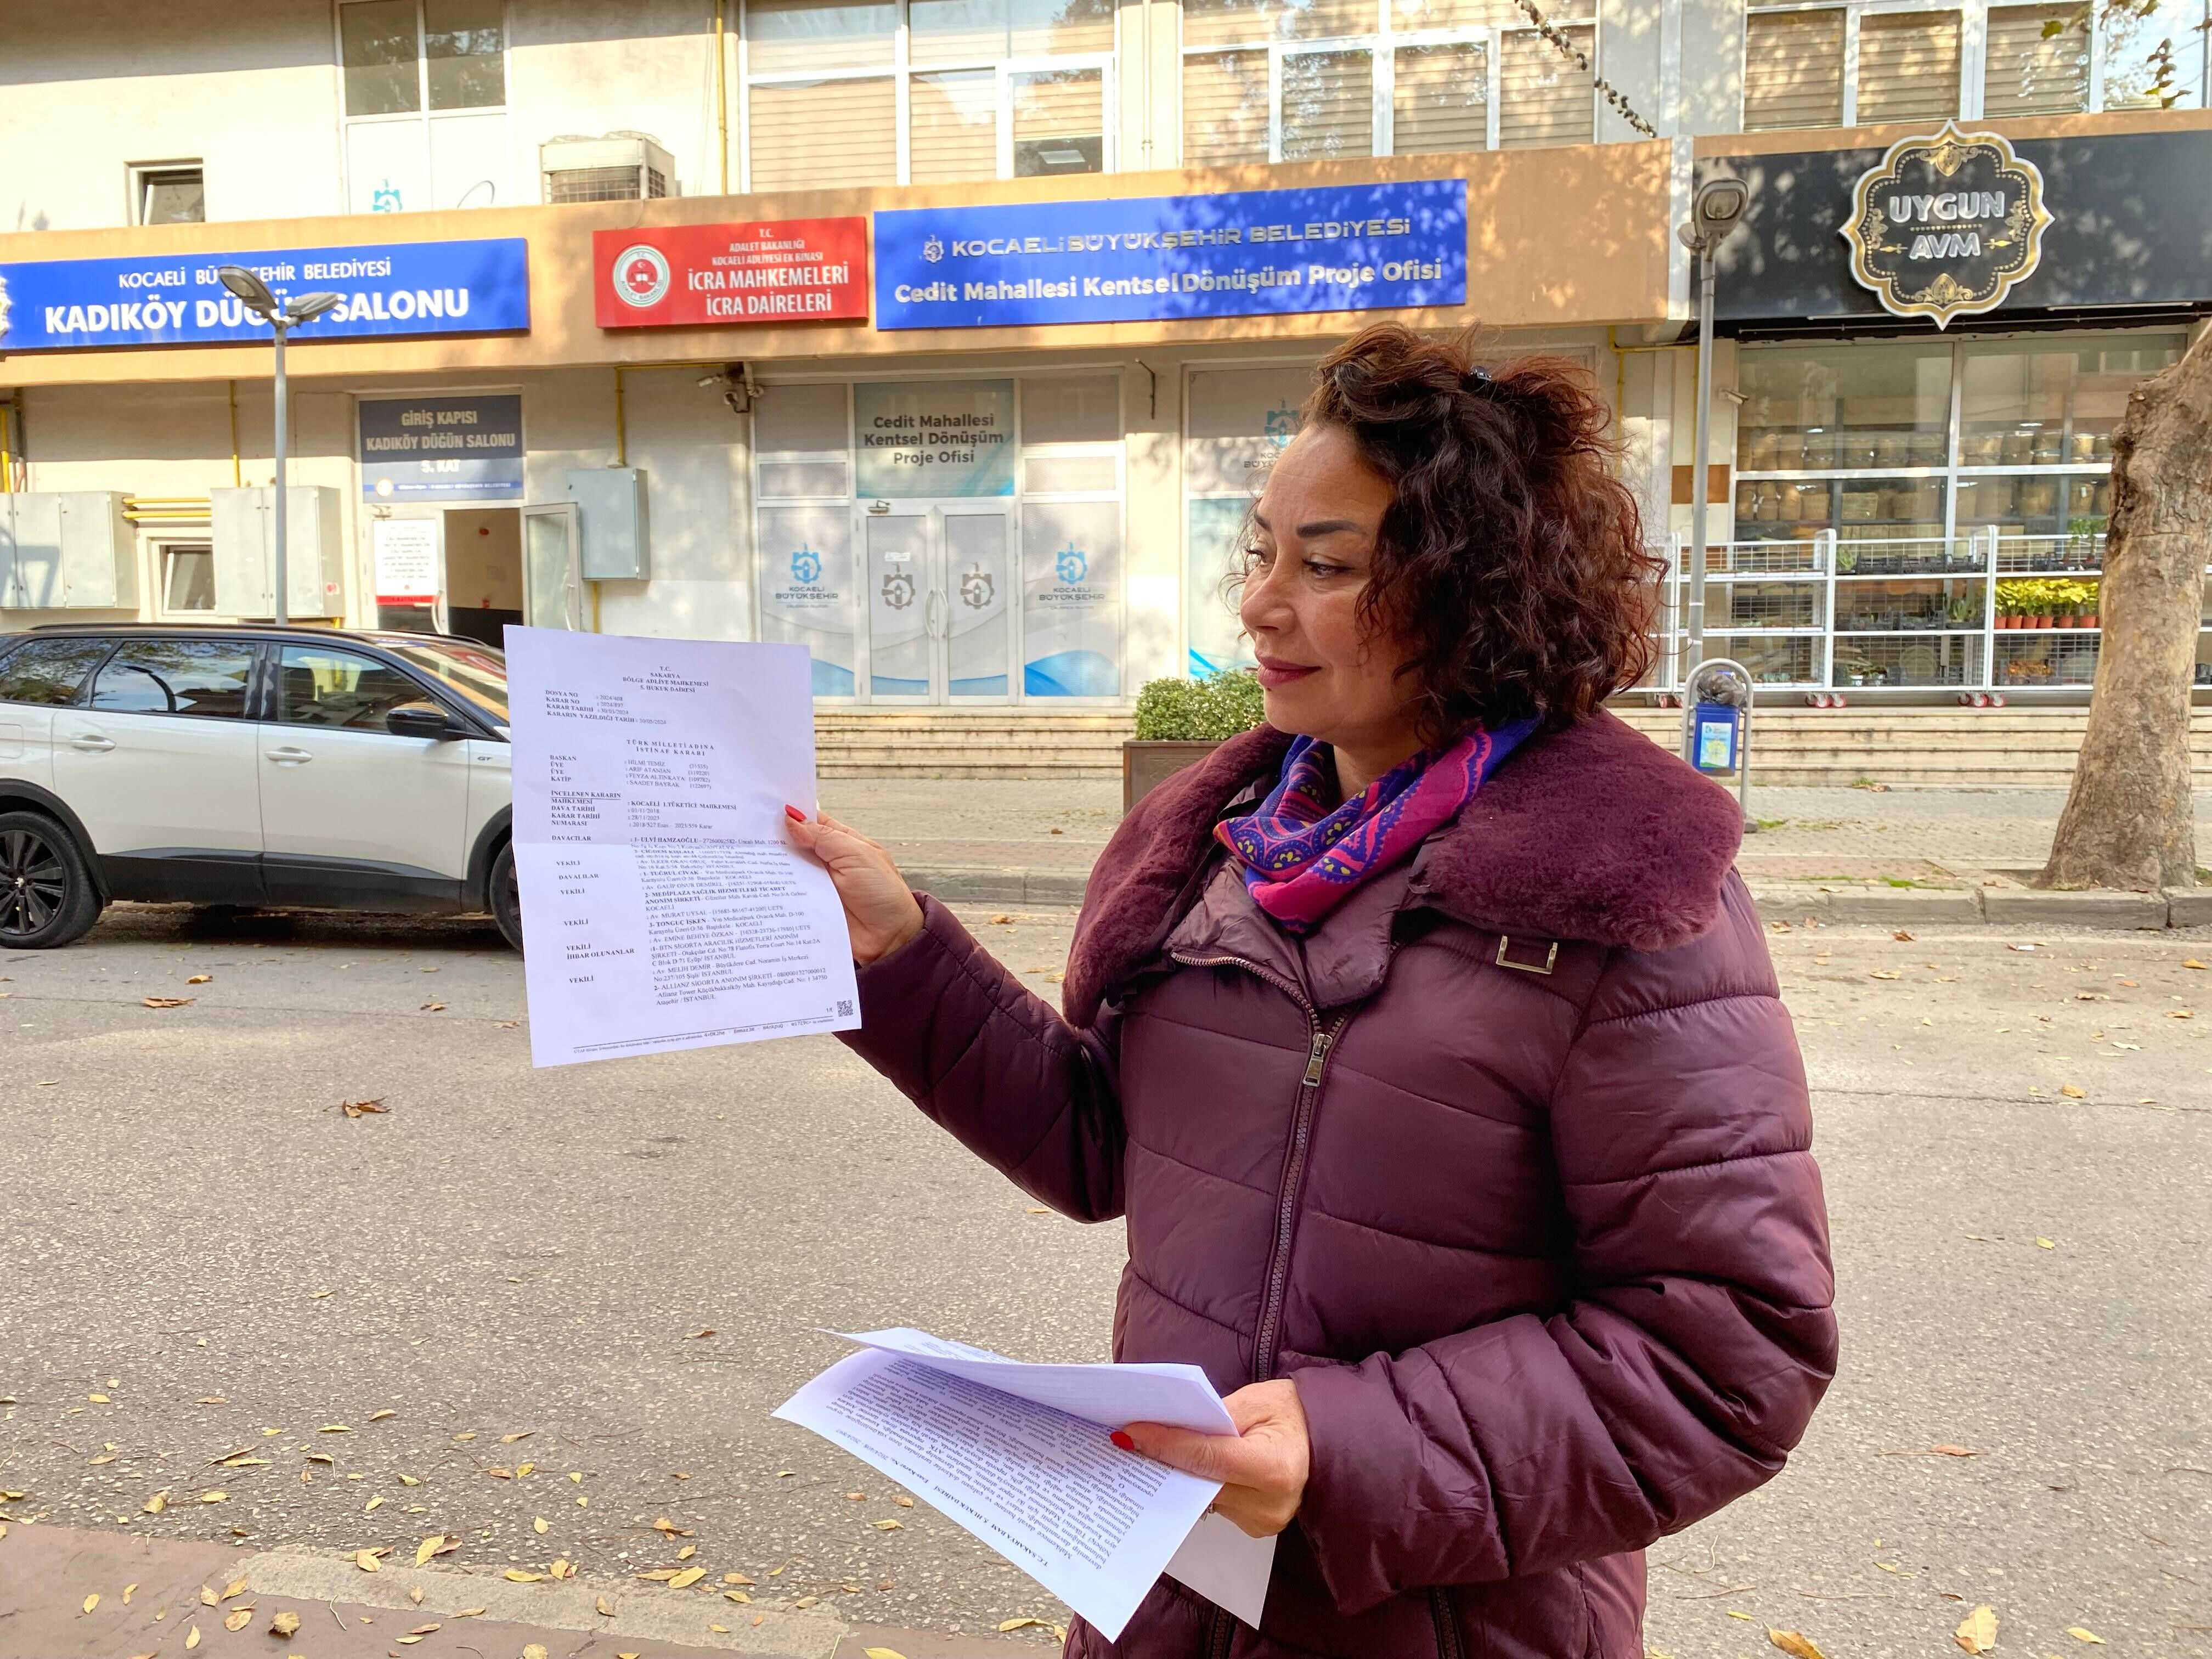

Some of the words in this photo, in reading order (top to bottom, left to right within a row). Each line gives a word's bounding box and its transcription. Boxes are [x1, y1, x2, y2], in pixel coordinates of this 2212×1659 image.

[1889, 191, 2005, 223] UYGUN
[729, 241, 759, 252] ADALET
[760, 238, 805, 251] BAKANLIĞI
[952, 236, 1064, 257] KOCAELİ
[1068, 228, 1242, 252] BÜYÜKŞEHİR
[1249, 218, 1410, 243] BELEDİYESİ
[1909, 232, 1982, 260] AVM
[712, 253, 745, 266] KOCAELİ
[746, 252, 782, 264] ADLİYESİ
[783, 253, 794, 263] EK
[795, 251, 823, 263] BİNASI
[119, 267, 185, 289] KOCAELİ
[195, 262, 296, 285] BÜEHİR
[303, 257, 391, 280] BELEDİYESİ
[689, 268, 726, 291] İCRA
[729, 261, 849, 289] MAHKEMELERİ
[895, 281, 958, 303] Cedit
[964, 276, 1077, 301] Mahallesi
[1083, 273, 1178, 297] Kentsel
[1183, 266, 1301, 294] Dönüşüm
[1308, 262, 1375, 289] Proje
[1383, 258, 1442, 281] Ofisi
[46, 294, 188, 334] KADIKÖY
[330, 289, 469, 323] SALONU
[706, 294, 744, 317] İCRA
[747, 289, 832, 314] DAİRELERİ
[402, 409, 433, 428] GİRİŞ
[437, 410, 477, 425] KAPISI
[873, 415, 915, 429] Cedit
[919, 413, 994, 428] Mahallesi
[366, 433, 418, 451] KADIKÖY
[422, 432, 463, 450] DÜĞÜN
[466, 433, 515, 448] SALONU
[864, 432, 923, 447] Kentsel
[928, 431, 1003, 448] Dönüşüm
[421, 459, 435, 473] 5.
[438, 459, 460, 472] KAT
[894, 452, 933, 466] Proje
[939, 450, 974, 463] Ofisi
[580, 713, 613, 721] YAZILDIĞI
[551, 789, 589, 798] İNCELENEN
[645, 897, 673, 905] ANONİM
[566, 943, 591, 951] VEKİLİ
[591, 949, 635, 958] OLUNANLAR
[569, 975, 594, 984] VEKİLİ
[933, 1485, 960, 1505] DAİRESİ
[958, 1501, 983, 1520] HUKUK
[990, 1523, 1006, 1536] BAM
[1005, 1533, 1037, 1558] SAKARYA
[1035, 1530, 1073, 1559] Mahkemece
